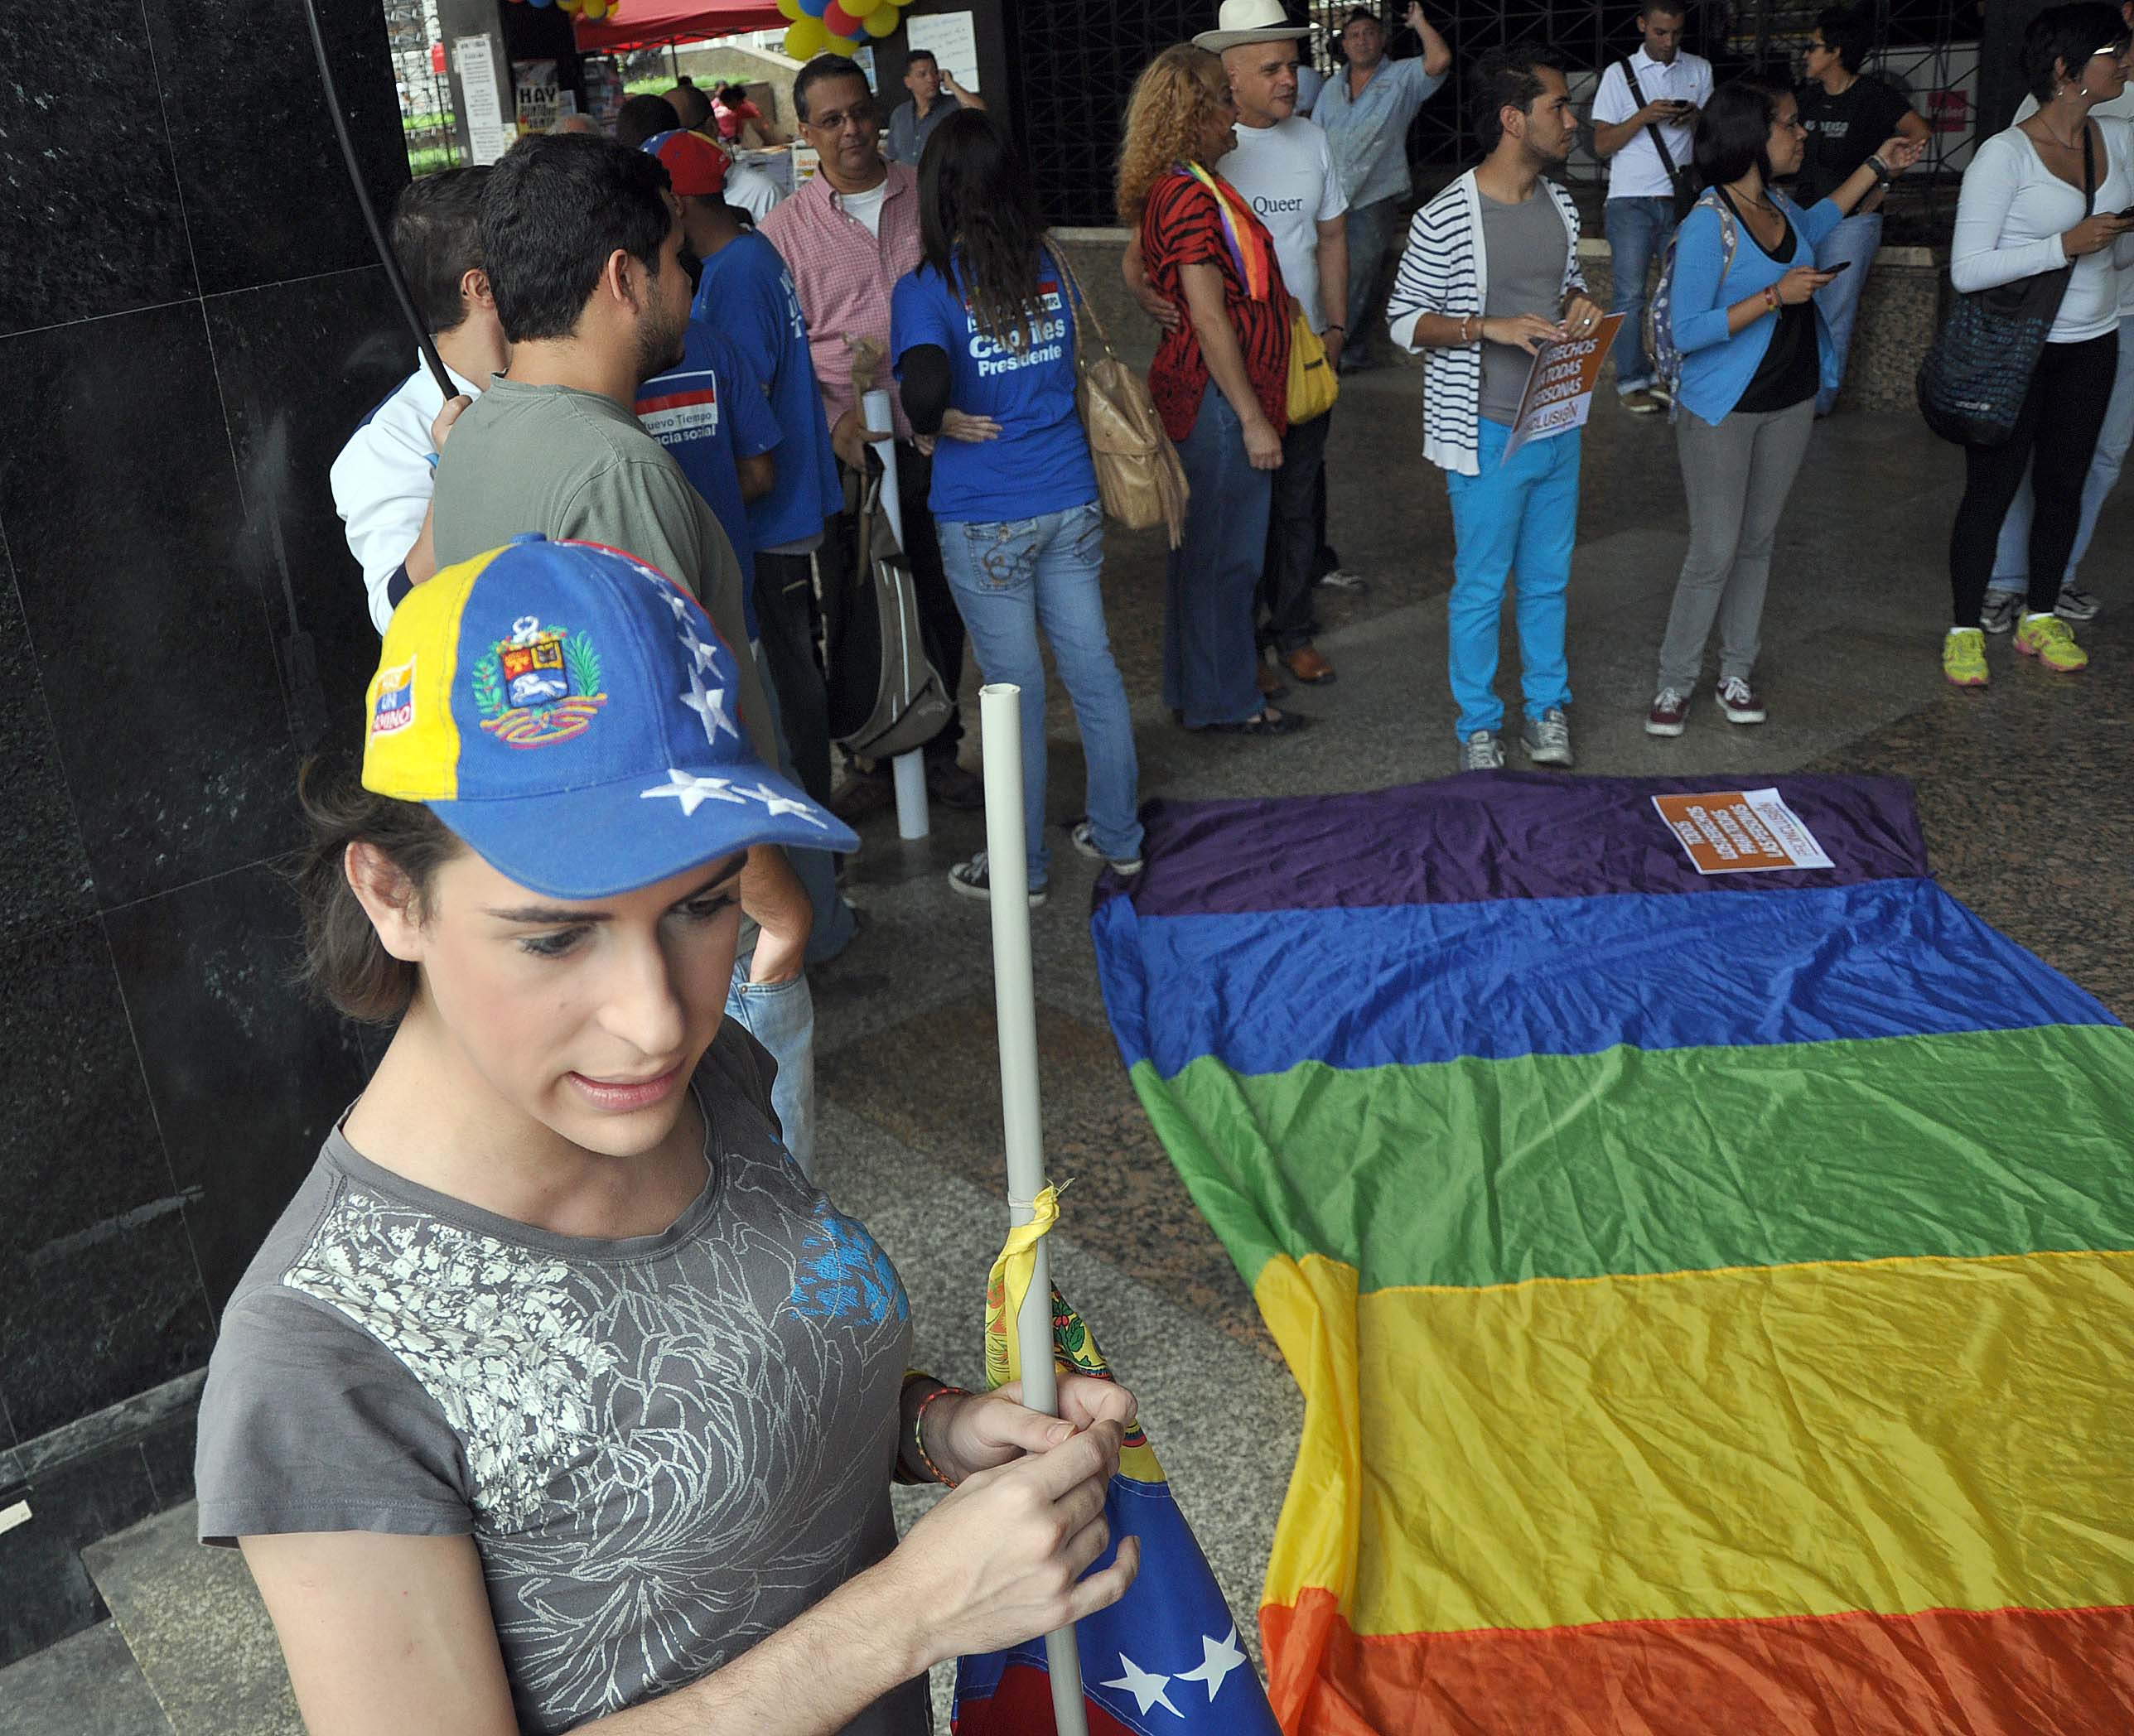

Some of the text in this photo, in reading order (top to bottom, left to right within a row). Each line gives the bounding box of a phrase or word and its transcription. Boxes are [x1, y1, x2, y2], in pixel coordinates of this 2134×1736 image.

[520, 88, 556, 104] HAY
[1253, 195, 1303, 217] Queer
[645, 412, 712, 430] uevo Tiempo
[683, 423, 717, 441] social
